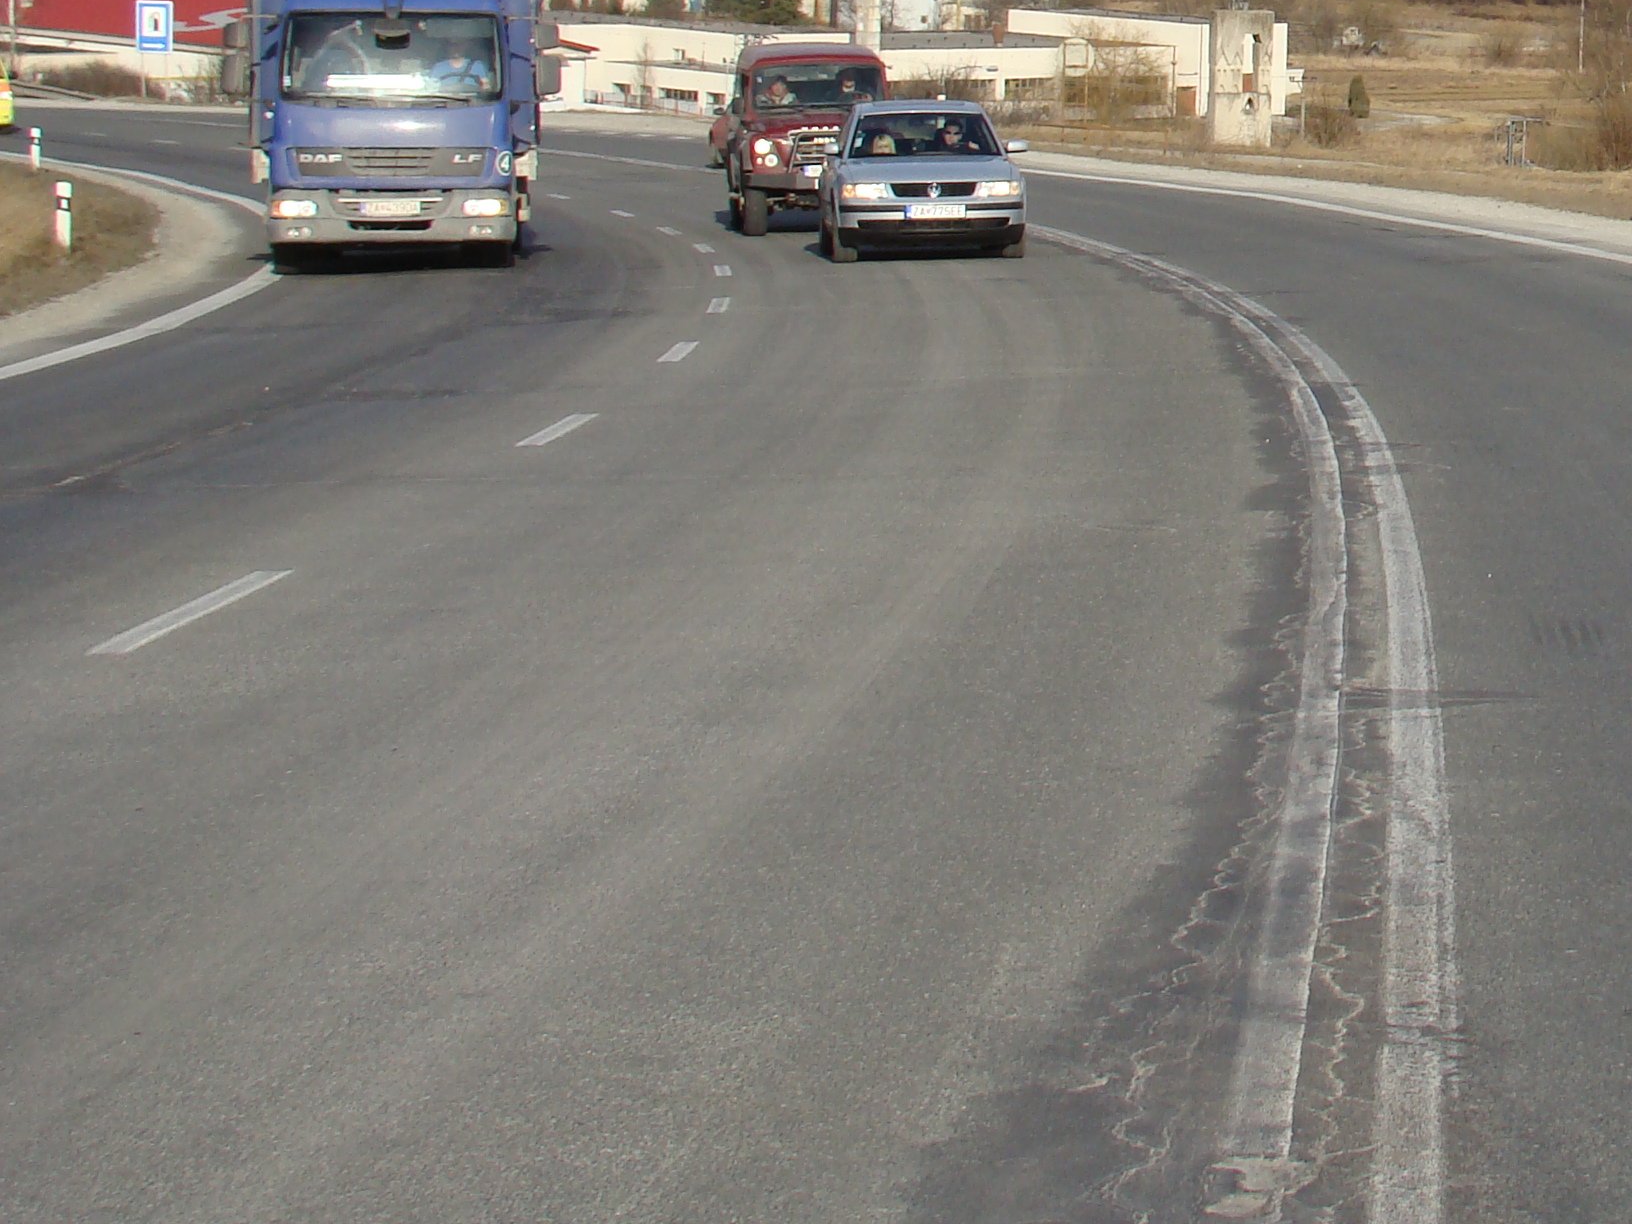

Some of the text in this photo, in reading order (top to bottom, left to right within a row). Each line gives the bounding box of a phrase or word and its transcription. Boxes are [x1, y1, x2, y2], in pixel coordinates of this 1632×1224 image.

[299, 153, 343, 163] DAF
[452, 153, 483, 163] LF
[500, 154, 510, 172] 4
